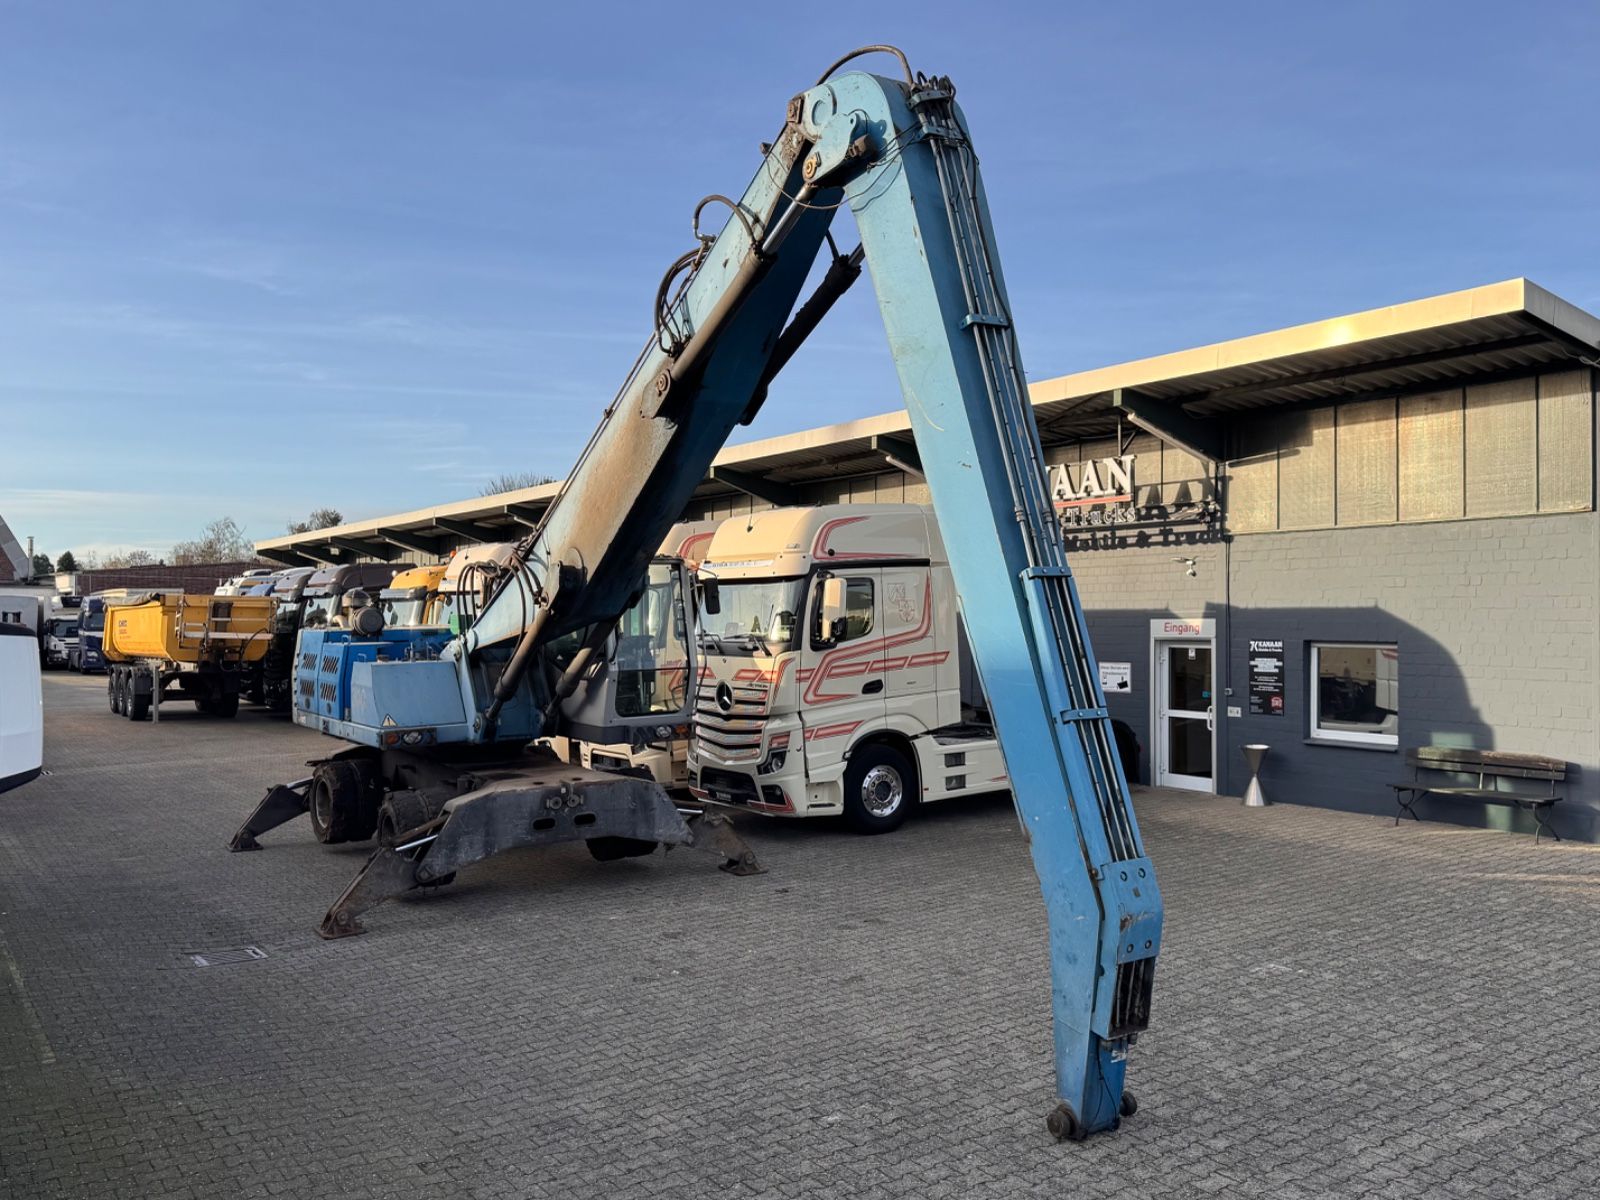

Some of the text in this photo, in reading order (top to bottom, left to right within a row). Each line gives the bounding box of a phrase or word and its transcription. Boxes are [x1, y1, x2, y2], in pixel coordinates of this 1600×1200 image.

[1046, 454, 1137, 500] AAN
[1066, 503, 1136, 526] Trucks
[1163, 622, 1200, 635] Eingang
